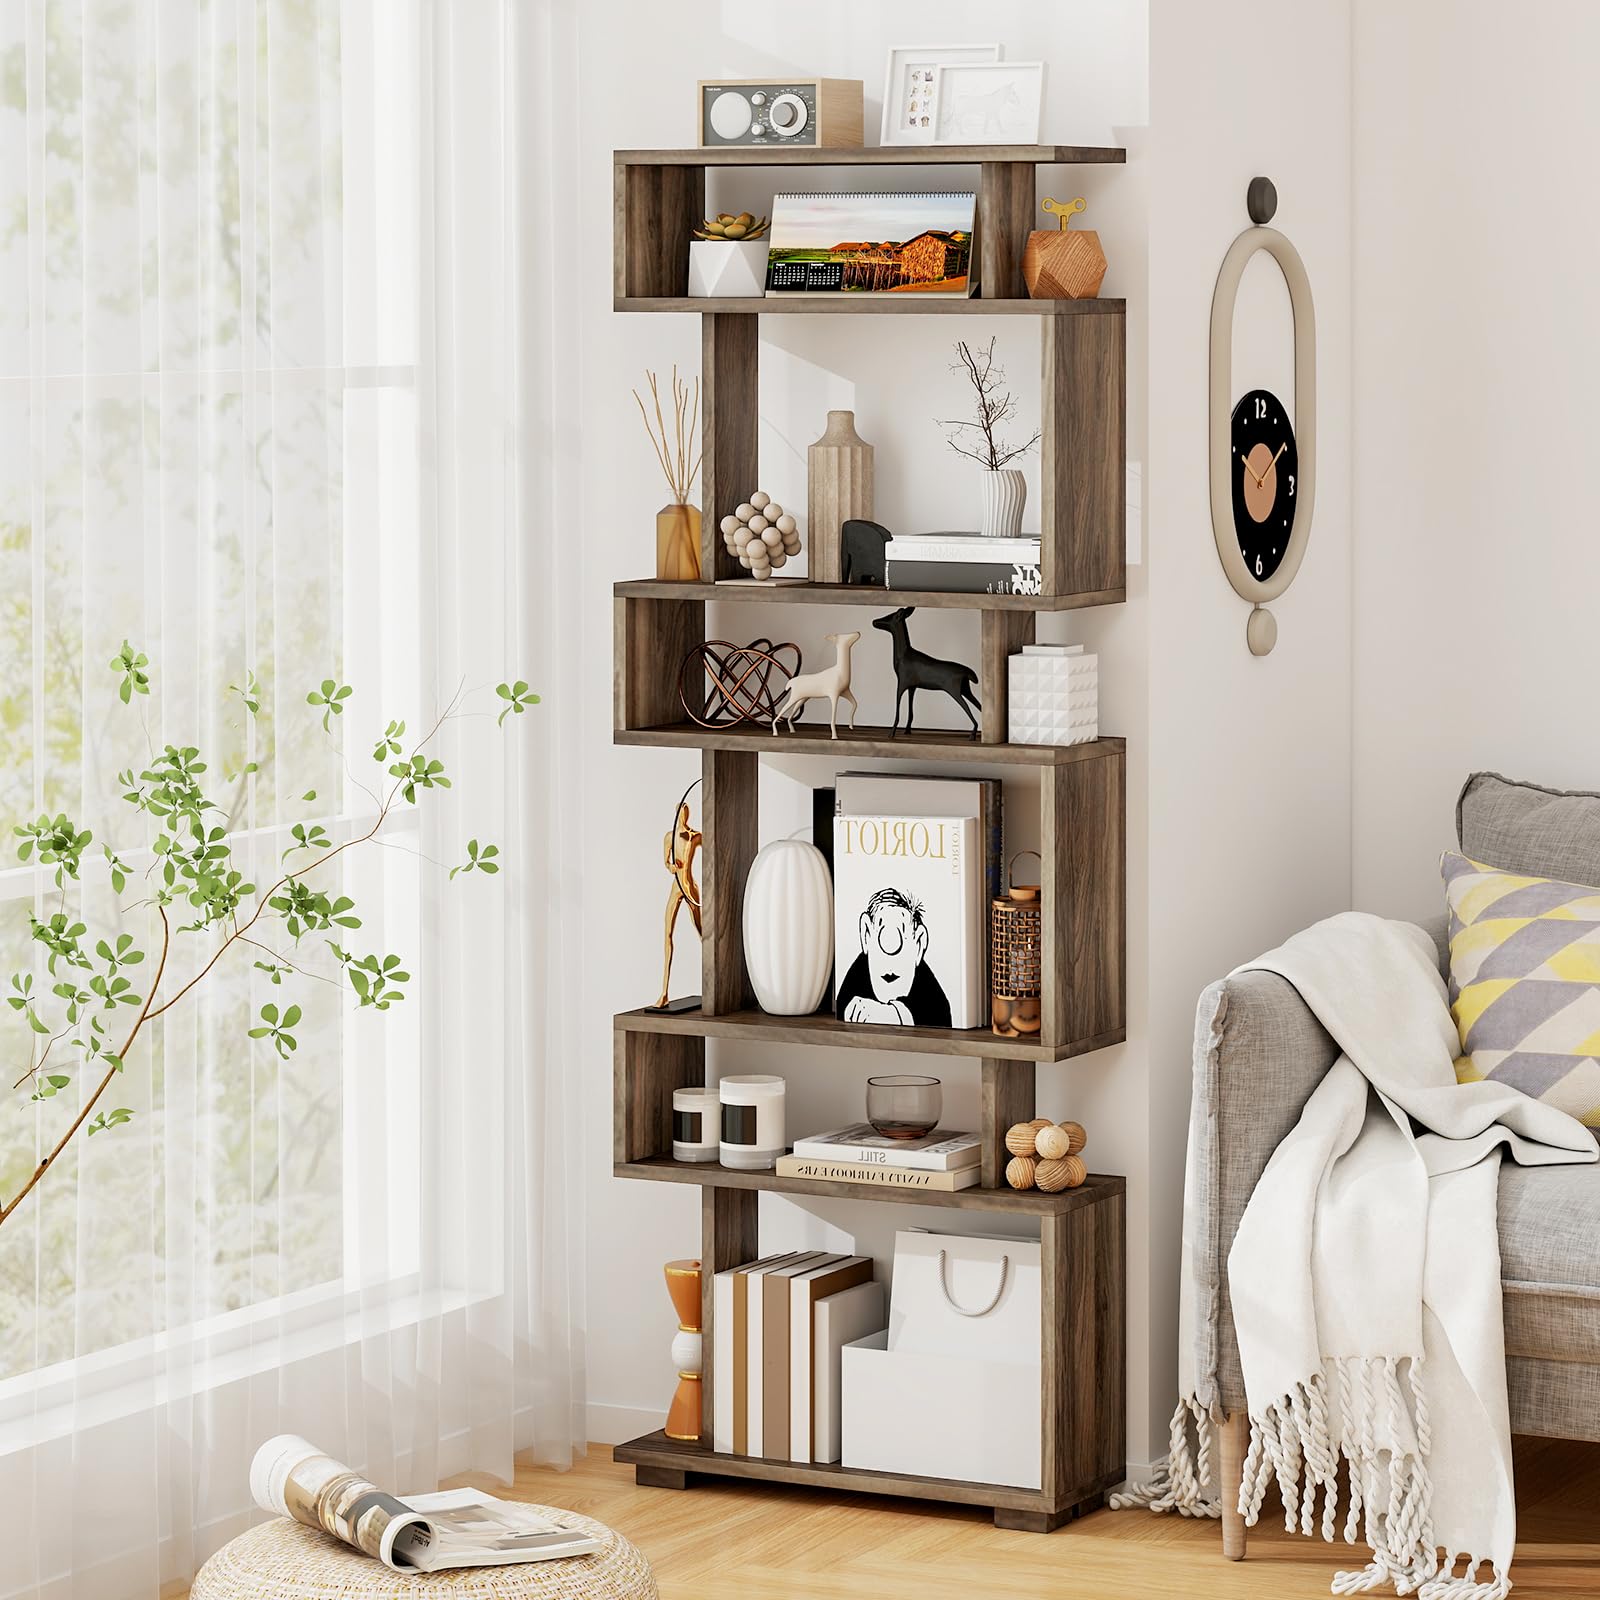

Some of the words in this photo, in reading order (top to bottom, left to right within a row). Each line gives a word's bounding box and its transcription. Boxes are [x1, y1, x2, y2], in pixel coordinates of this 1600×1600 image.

[1254, 397, 1267, 419] 12
[1288, 475, 1295, 496] 3
[1255, 554, 1263, 576] 6
